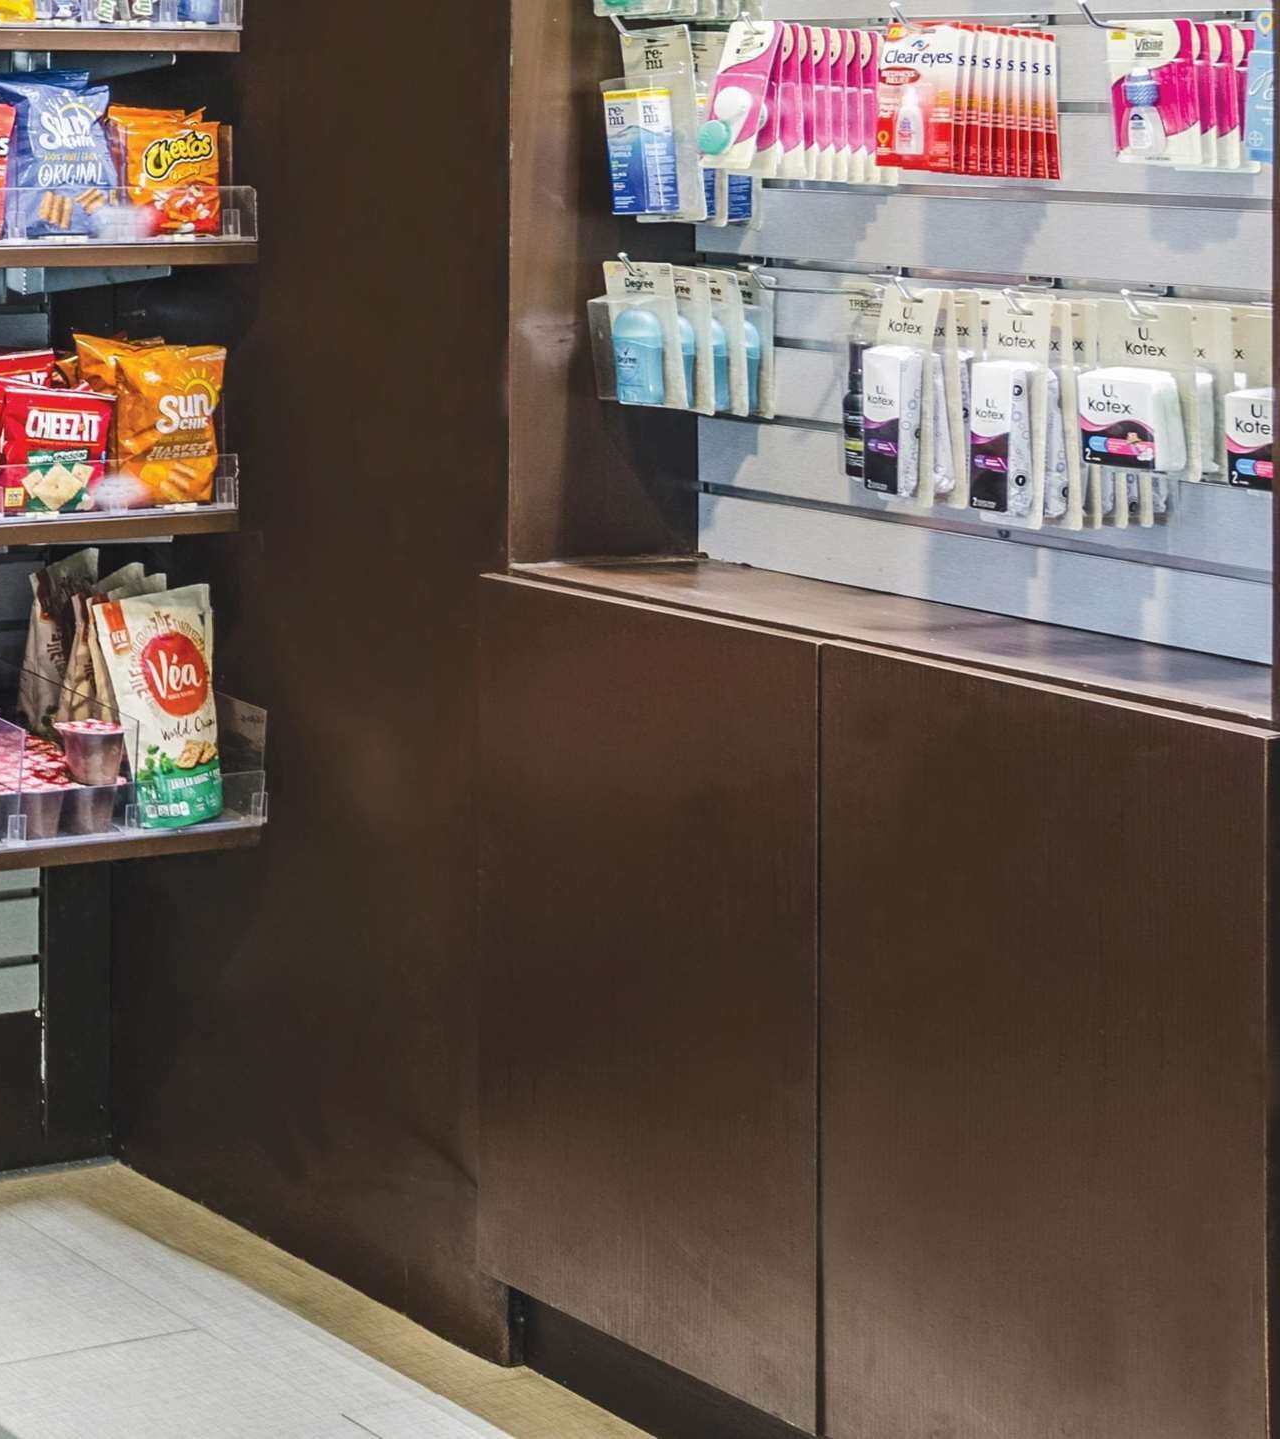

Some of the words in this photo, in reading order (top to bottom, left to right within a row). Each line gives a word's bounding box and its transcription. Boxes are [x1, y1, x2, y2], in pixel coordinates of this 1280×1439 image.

[645, 48, 663, 59] re-
[885, 49, 919, 65] Clear
[921, 50, 953, 66] eyes
[645, 59, 663, 71] nu
[145, 132, 215, 179] Cheetos
[624, 278, 654, 289] Degree
[888, 319, 922, 335] kotex
[998, 333, 1036, 350] kotex
[1125, 340, 1166, 358] kotex
[867, 395, 894, 408] kotex
[1087, 394, 1130, 414] kotex
[975, 407, 1005, 421] kotex
[1235, 417, 1270, 436] kote
[146, 648, 203, 702] Véa
